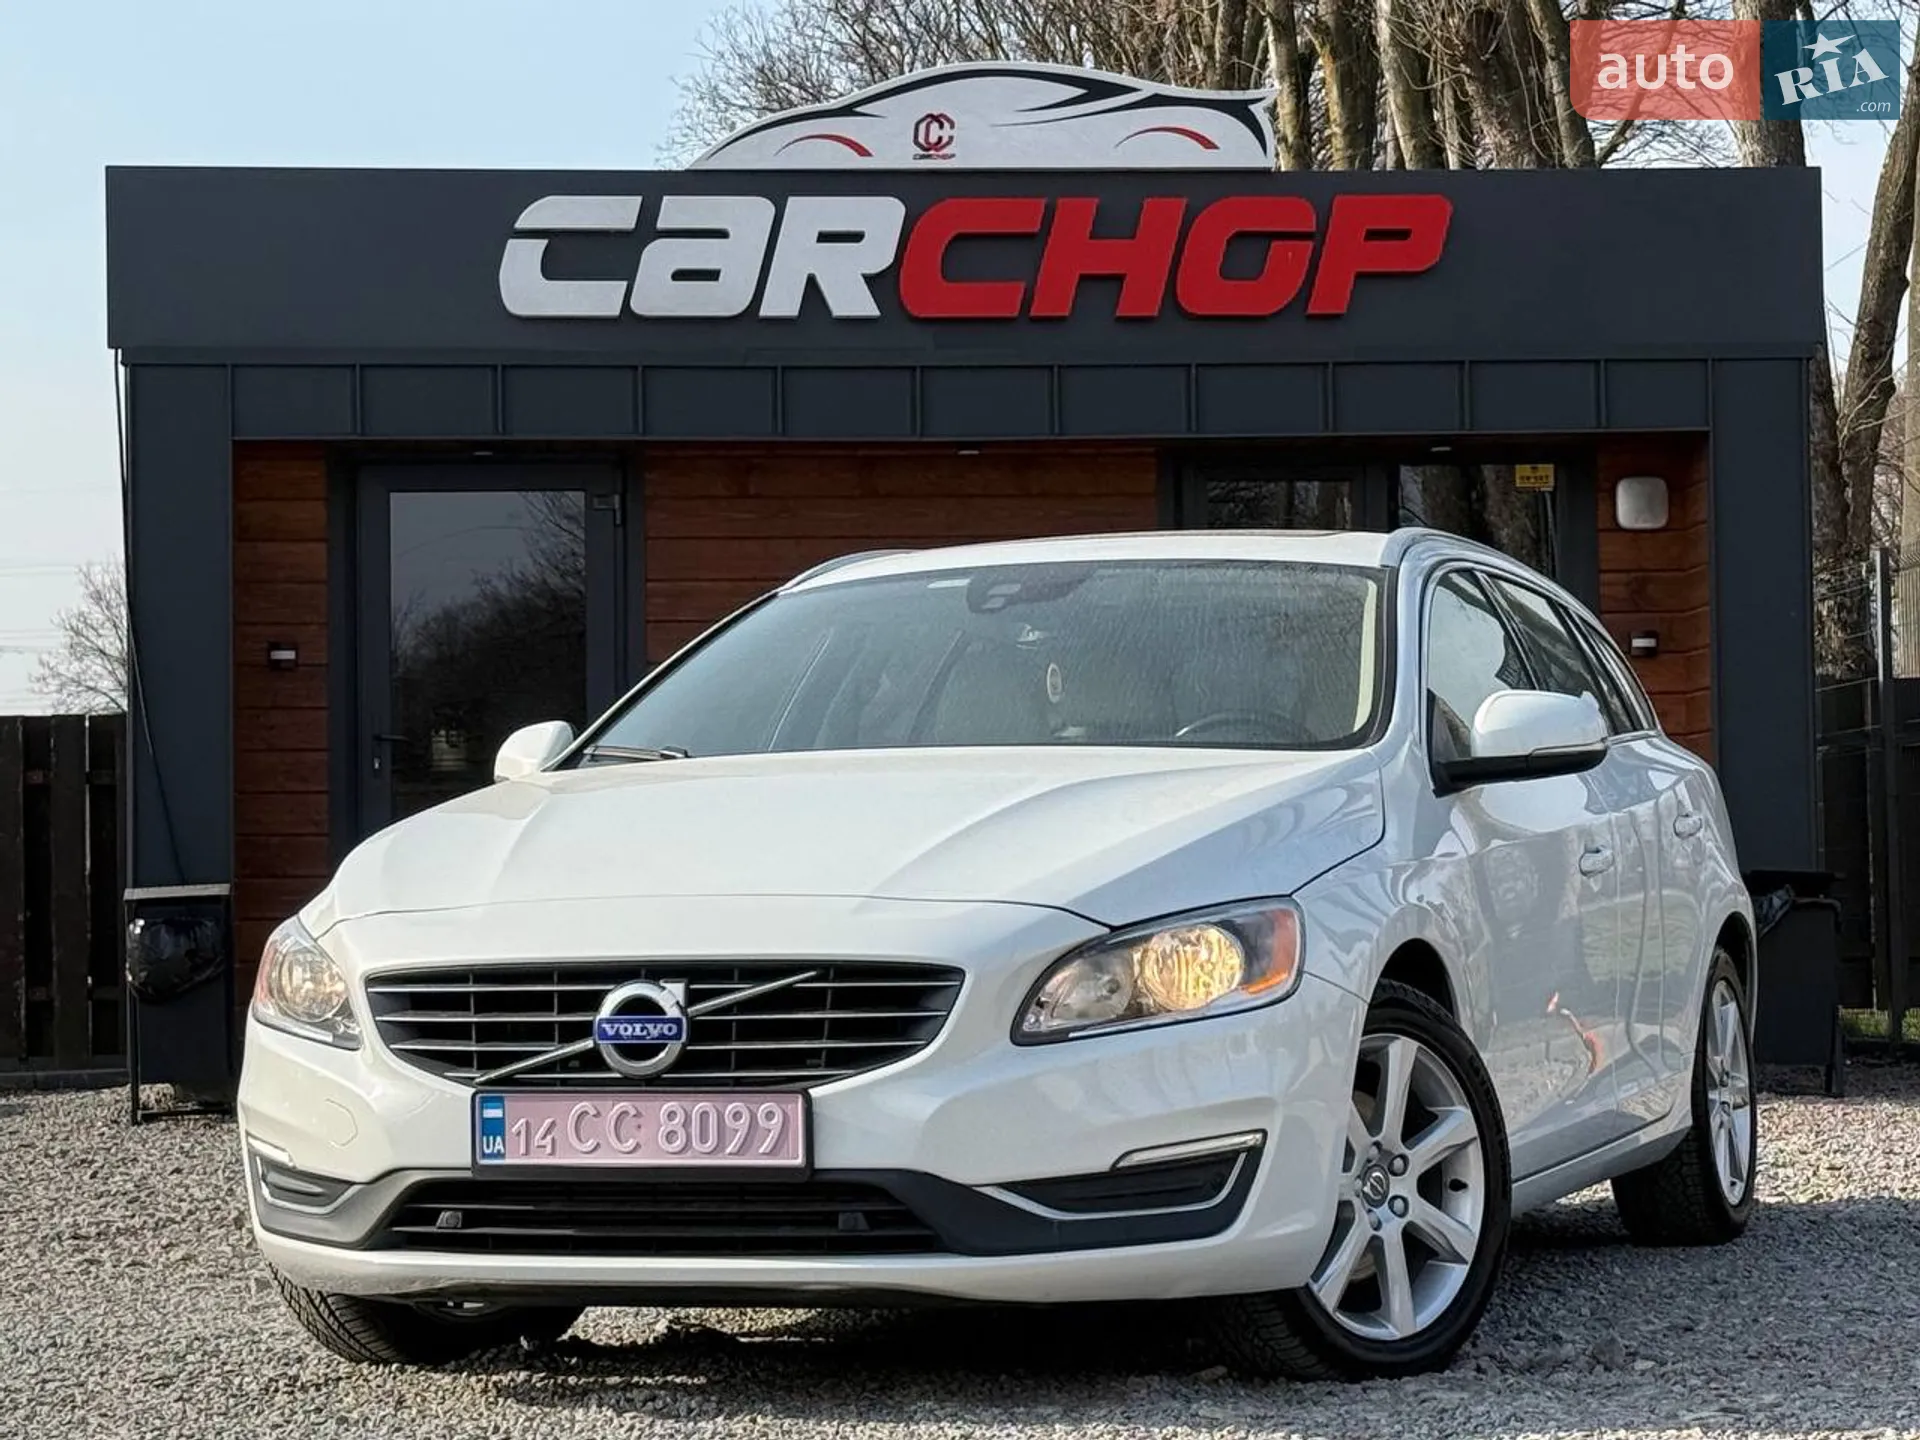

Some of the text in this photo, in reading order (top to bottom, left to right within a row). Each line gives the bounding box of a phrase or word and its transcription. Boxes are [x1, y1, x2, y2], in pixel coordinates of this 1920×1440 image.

[601, 1022, 678, 1040] VOLVO
[511, 1101, 785, 1156] 14 CC 8099
[482, 1135, 505, 1154] UA
